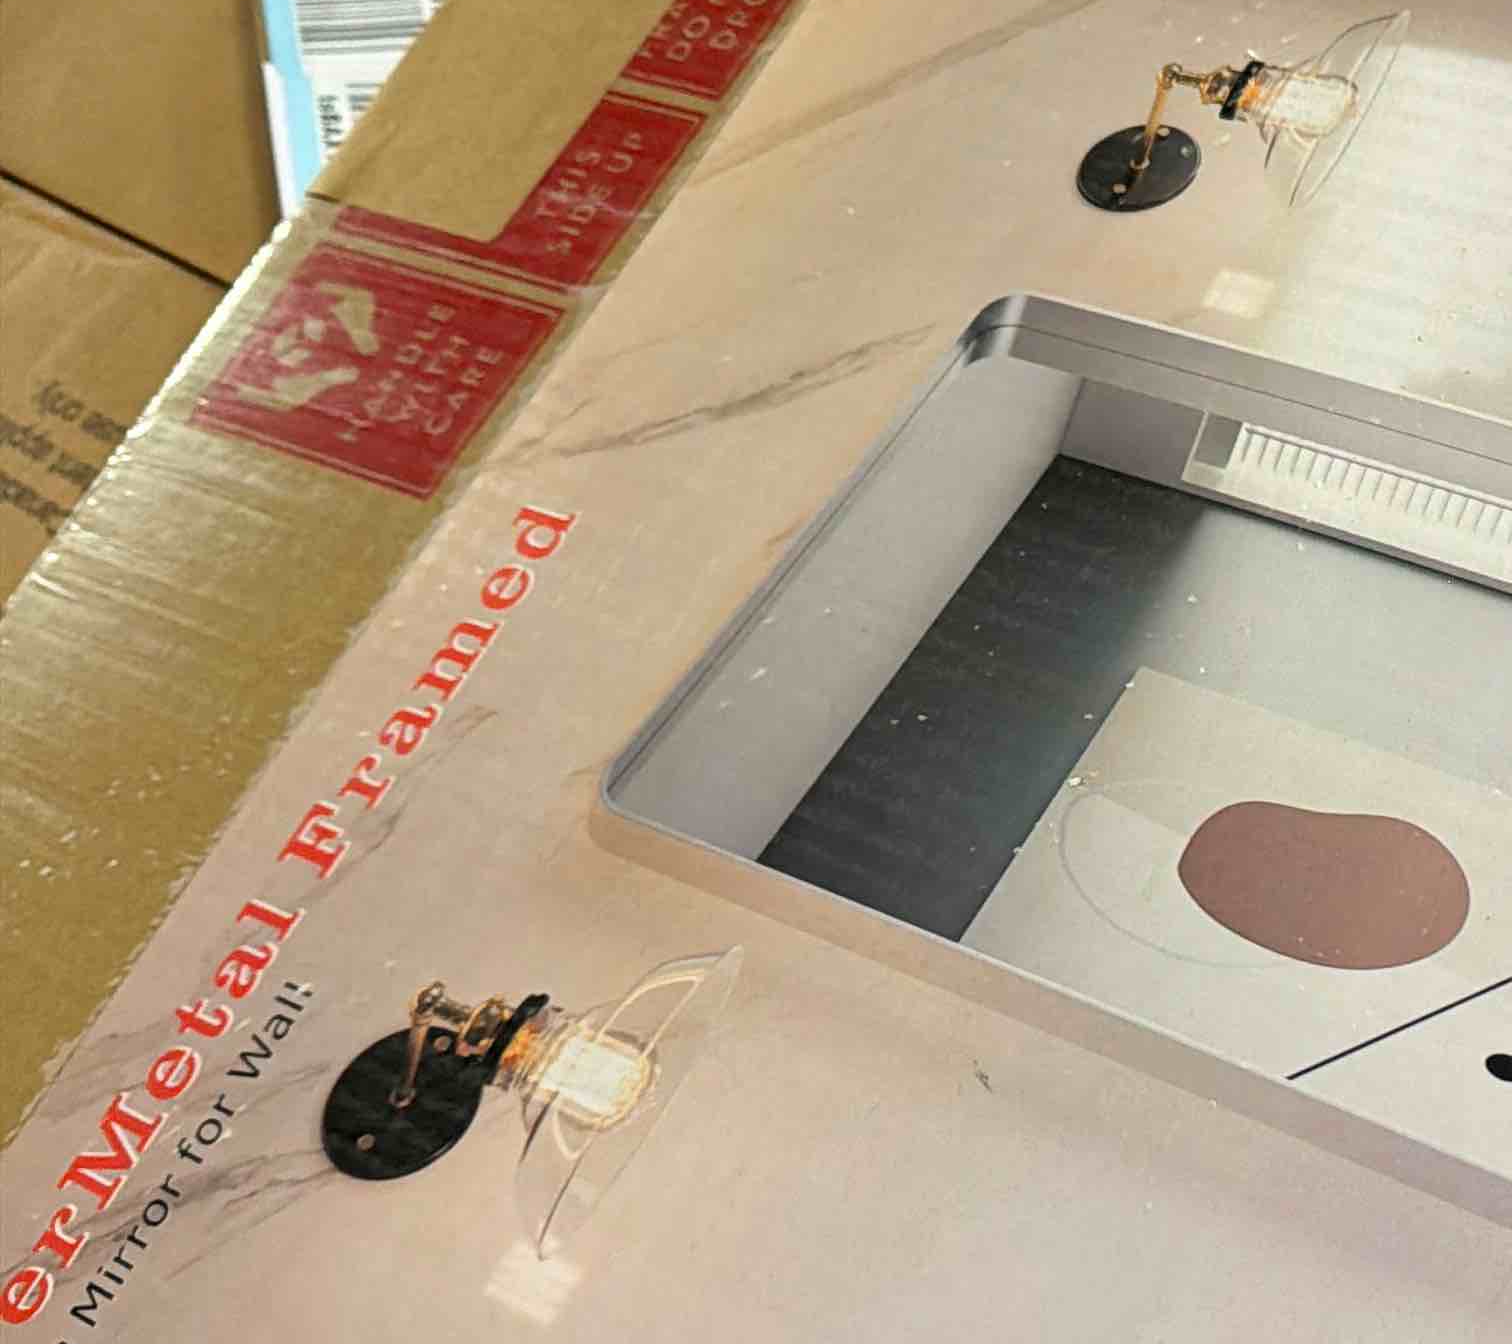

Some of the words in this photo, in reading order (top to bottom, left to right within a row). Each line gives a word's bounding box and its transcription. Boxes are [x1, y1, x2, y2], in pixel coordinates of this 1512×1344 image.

[670, 14, 712, 63] DO
[535, 147, 600, 221] THIS
[545, 178, 612, 256] SIDE
[606, 132, 647, 177] UP
[426, 347, 500, 437] CARE
[279, 504, 578, 879] Framed
[70, 1173, 183, 1327] Mirror
[177, 1094, 235, 1164] for
